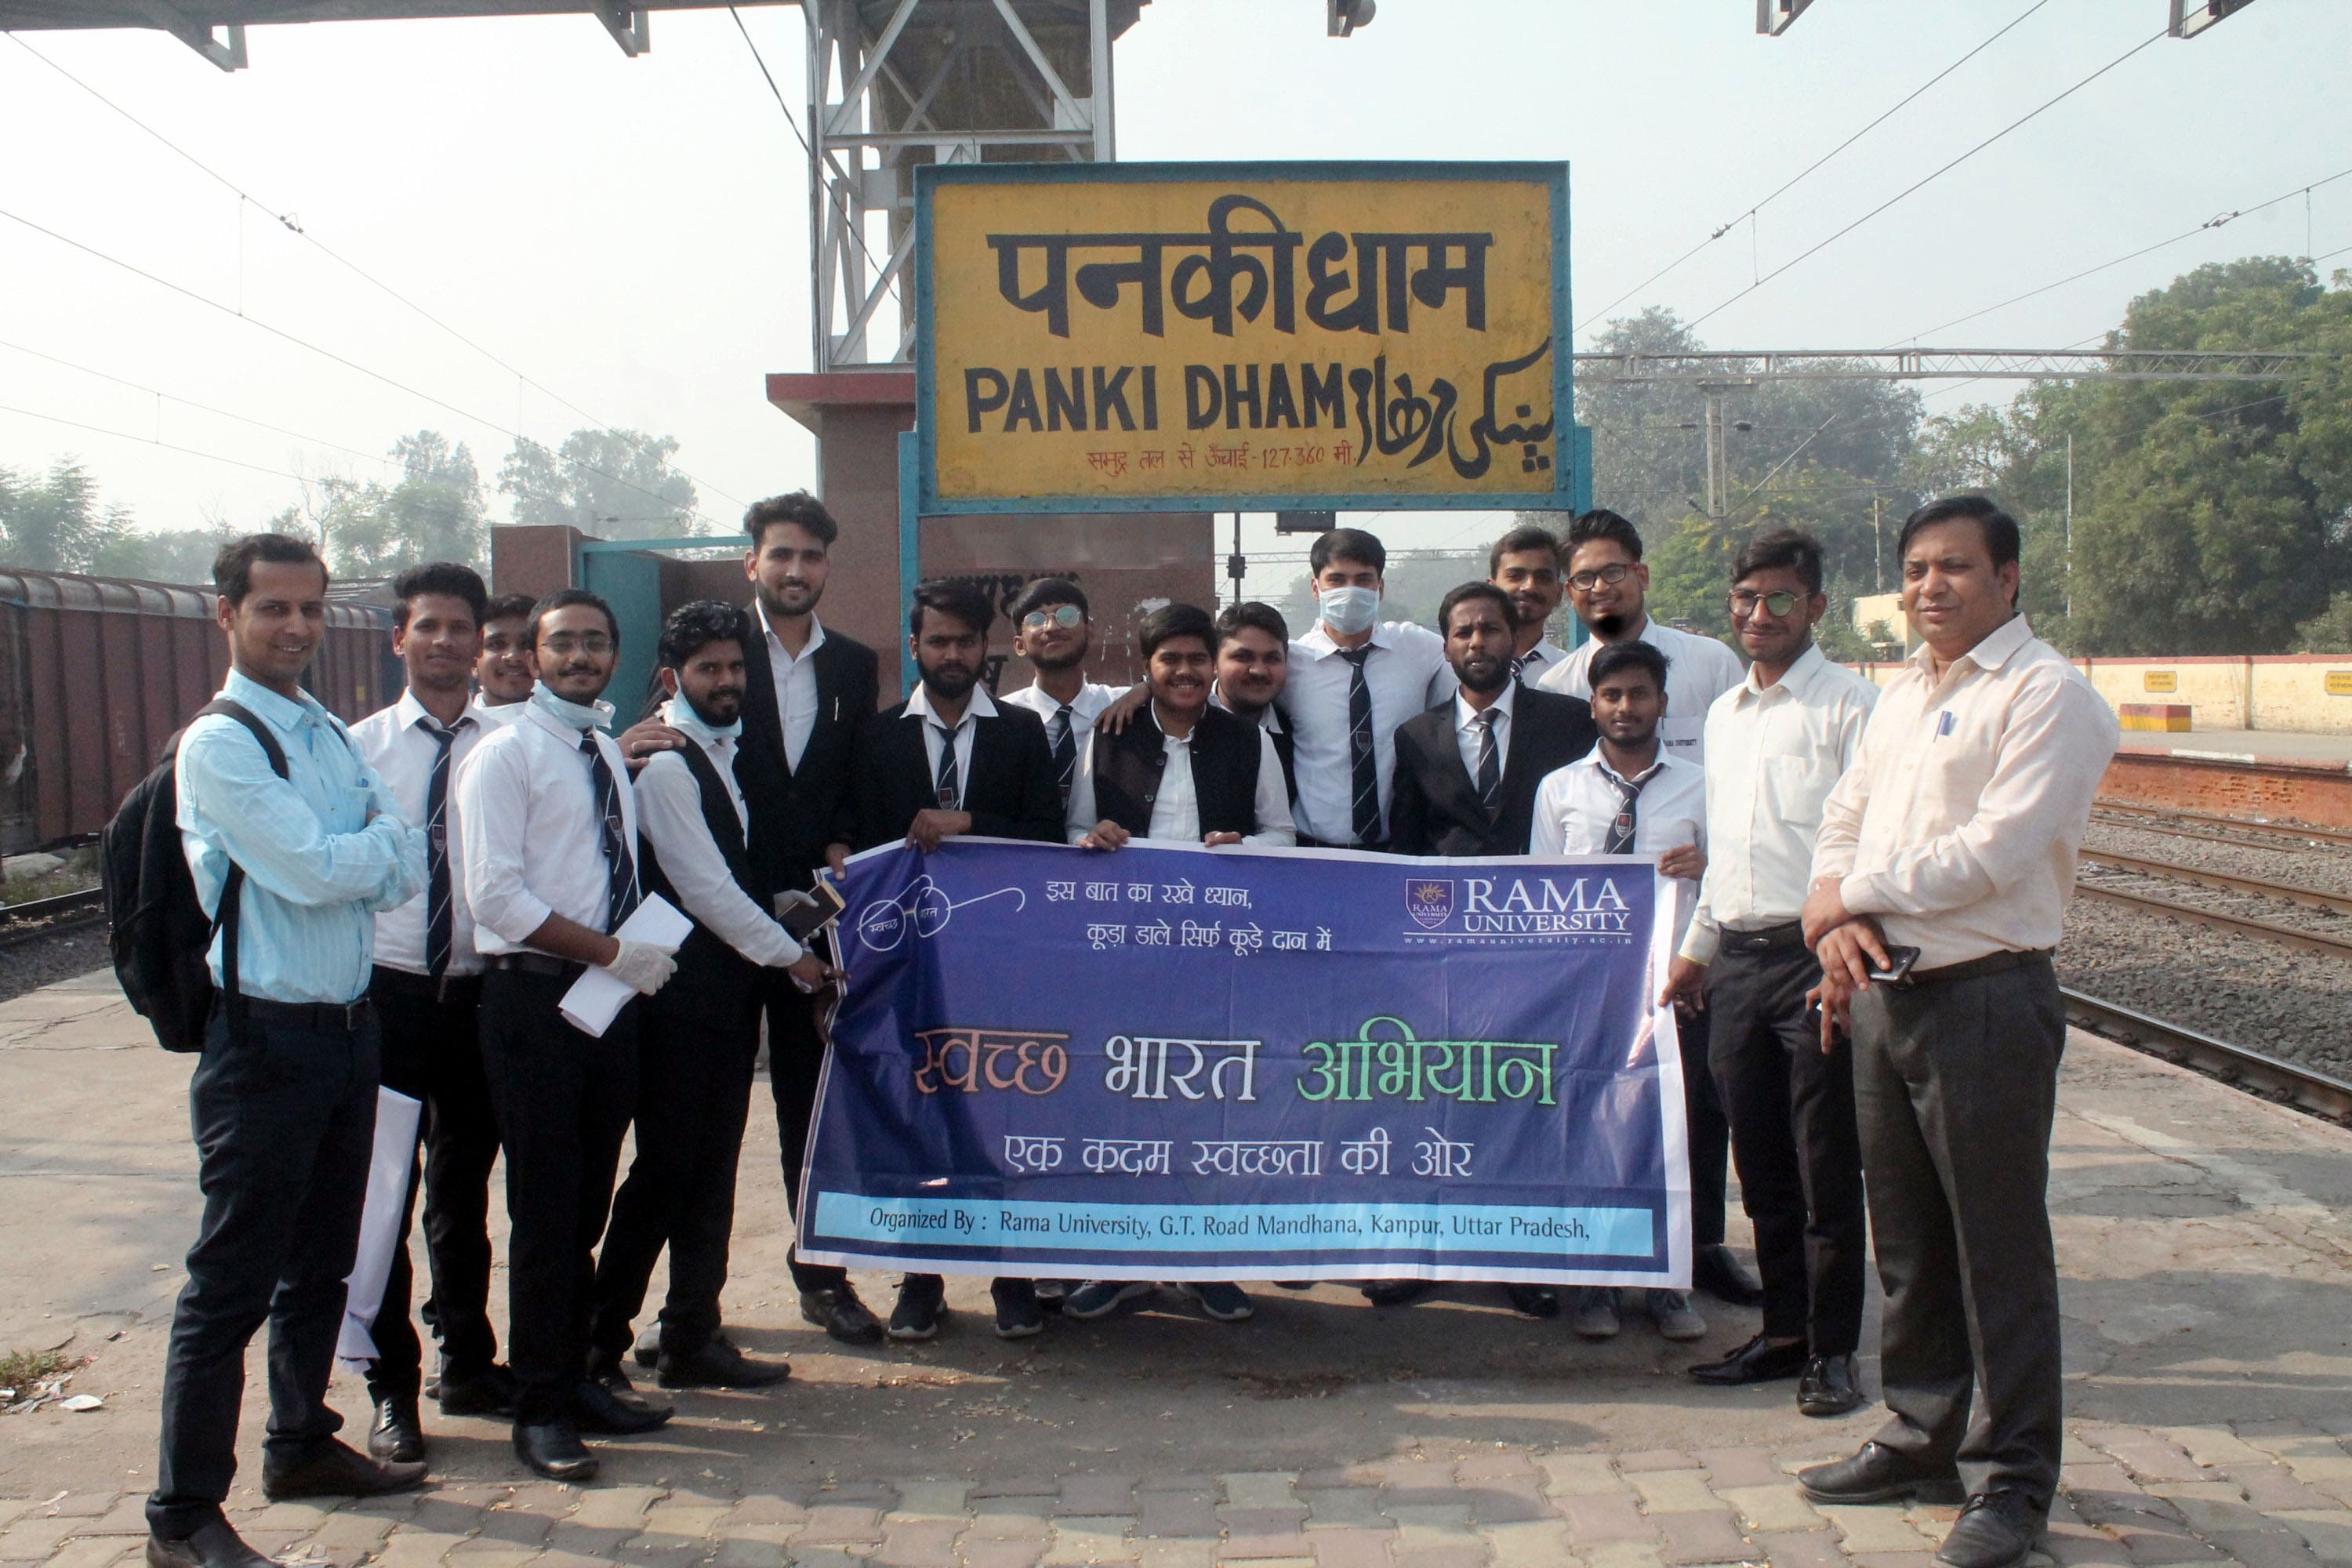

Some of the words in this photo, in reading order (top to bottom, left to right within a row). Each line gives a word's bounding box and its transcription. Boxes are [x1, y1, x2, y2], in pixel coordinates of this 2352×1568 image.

[964, 365, 1159, 433] PANKI
[1185, 363, 1347, 430] DHAM
[1087, 451, 1129, 477] समुद्र
[1139, 450, 1165, 469] तल
[1177, 441, 1196, 468] से
[1046, 881, 1076, 901] इस
[1085, 882, 1120, 902] बात
[1127, 884, 1152, 902] का
[1161, 878, 1195, 904] रखे
[1204, 887, 1252, 909] ध्यान,
[1463, 877, 1631, 913] RAMA
[1087, 924, 1127, 950] कूड़ा
[1135, 919, 1171, 946] डाले
[1181, 920, 1221, 947] सिर्फ
[1229, 922, 1263, 956] कूड़े
[1272, 930, 1308, 951] दान
[1316, 927, 1332, 951] में
[1464, 913, 1631, 932] UNIVERSITY
[914, 1028, 1069, 1094] स्वच्छ
[1105, 1035, 1261, 1101] भारत
[1298, 1016, 1558, 1105] अभियान
[1004, 1135, 1065, 1173] एक
[1083, 1138, 1174, 1178] कदम
[1191, 1142, 1323, 1176] स्वच्छता
[1341, 1127, 1392, 1175] की
[1412, 1127, 1474, 1177] ओर
[870, 1207, 947, 1232] Organized
[954, 1210, 975, 1235] By
[1000, 1211, 1051, 1232] Rama
[1058, 1214, 1152, 1239] University,
[1160, 1215, 1195, 1236] G.T.
[1204, 1215, 1249, 1236] Road
[1258, 1214, 1363, 1236] Mandhana,
[1371, 1214, 1444, 1238] Kanpur,
[1453, 1216, 1502, 1235] Uttar
[1510, 1216, 1590, 1241] Pradesh,
